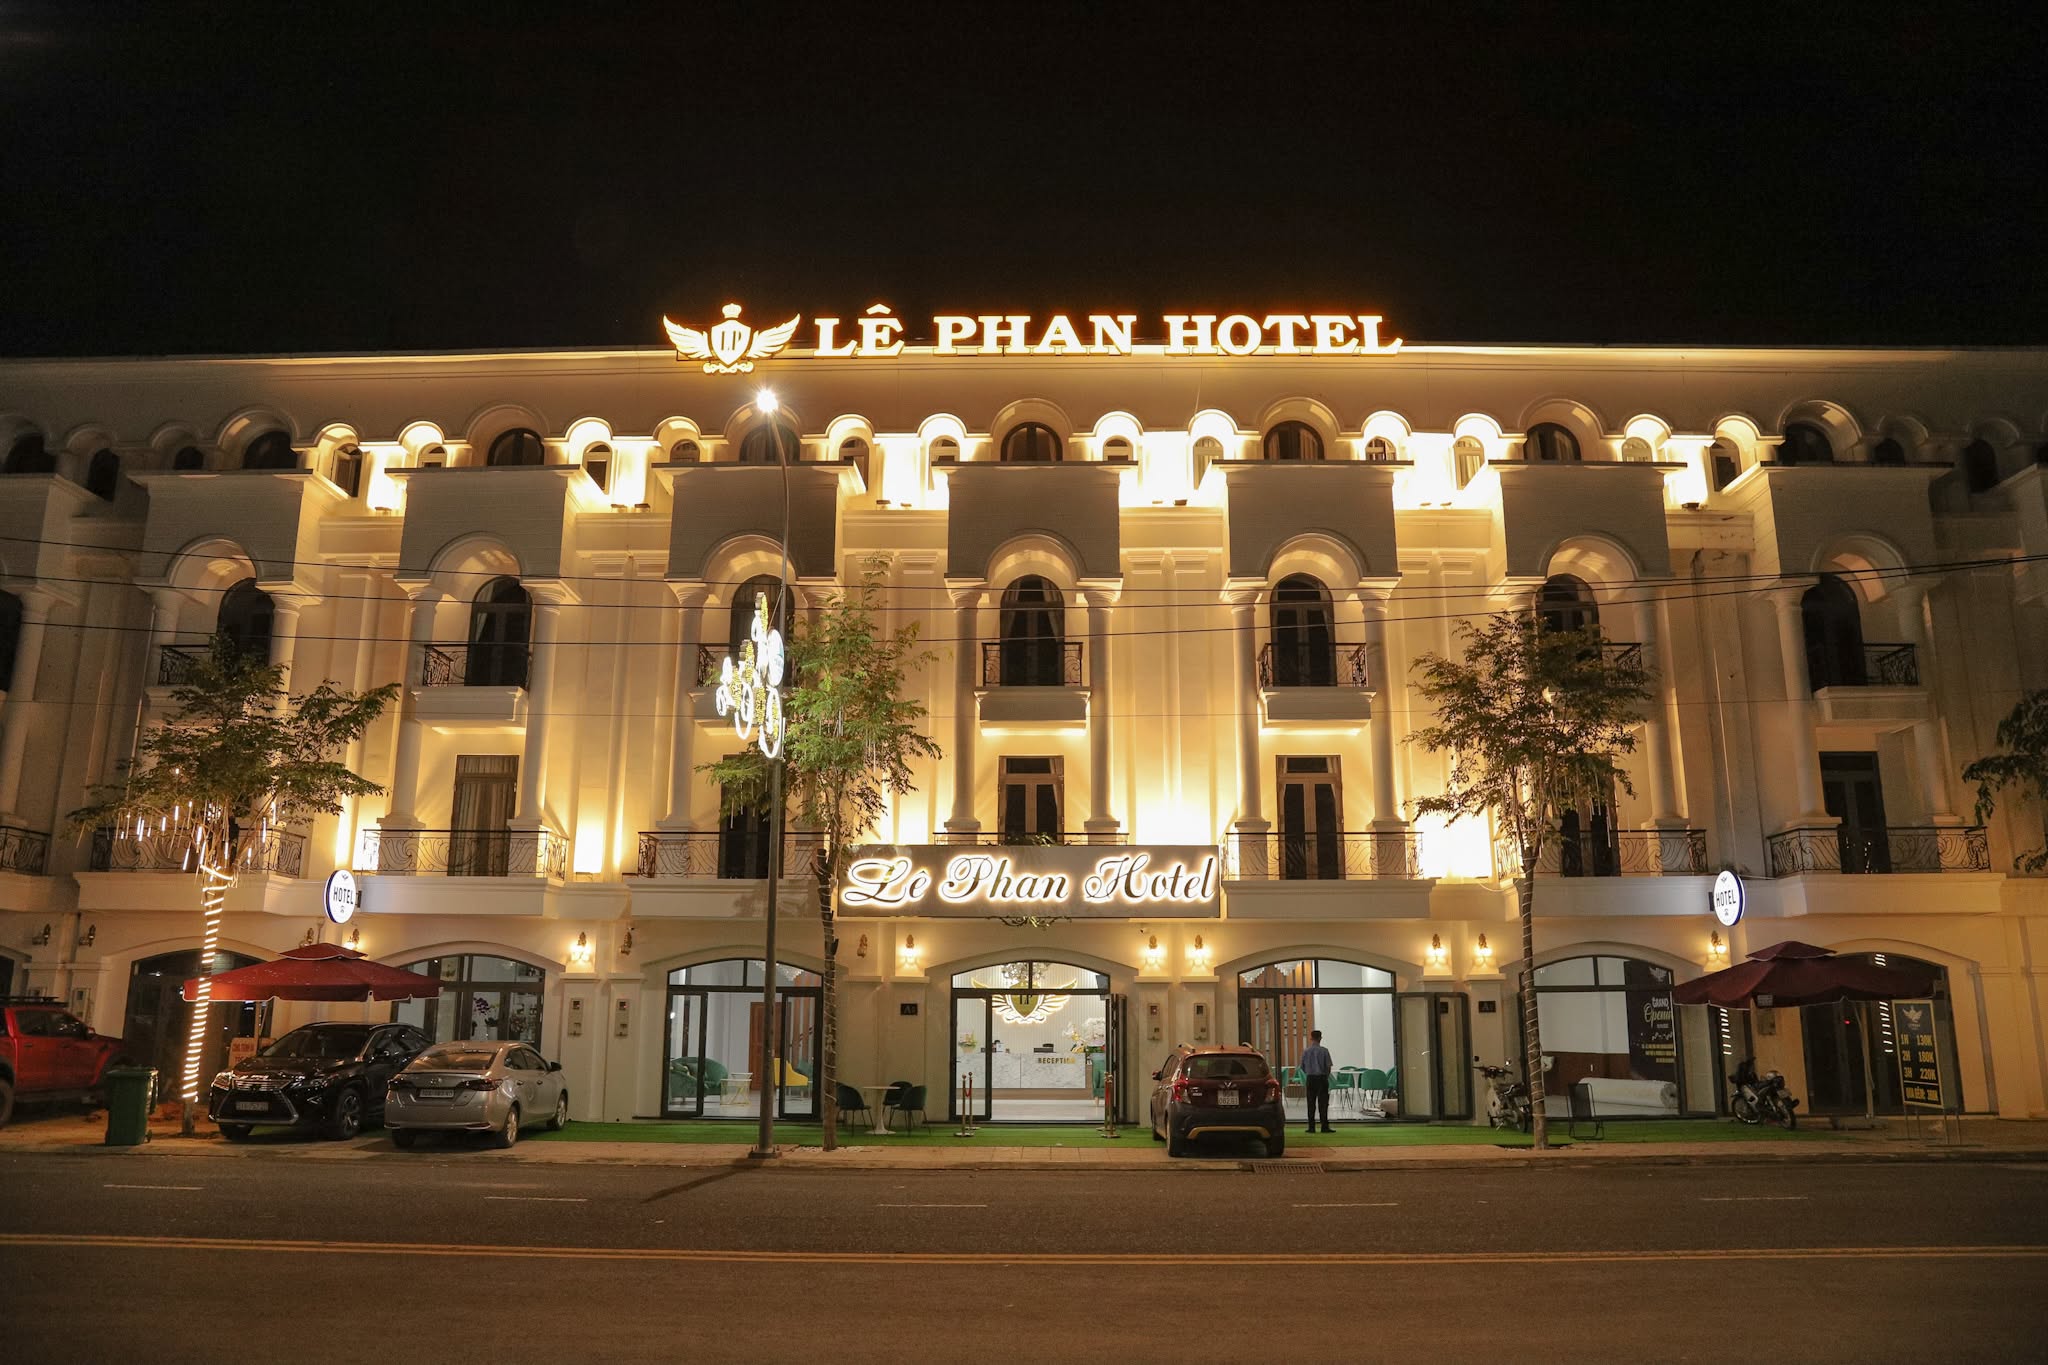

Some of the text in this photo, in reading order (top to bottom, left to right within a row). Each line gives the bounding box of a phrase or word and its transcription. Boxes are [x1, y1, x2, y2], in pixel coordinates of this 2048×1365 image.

[812, 304, 1404, 357] LÊ PHAN HOTEL
[941, 855, 1067, 900] Phan
[1083, 853, 1216, 902] Hotel
[332, 886, 354, 905] HOTEL
[1715, 888, 1737, 908] HOTEL
[1644, 1003, 1672, 1028] Openin
